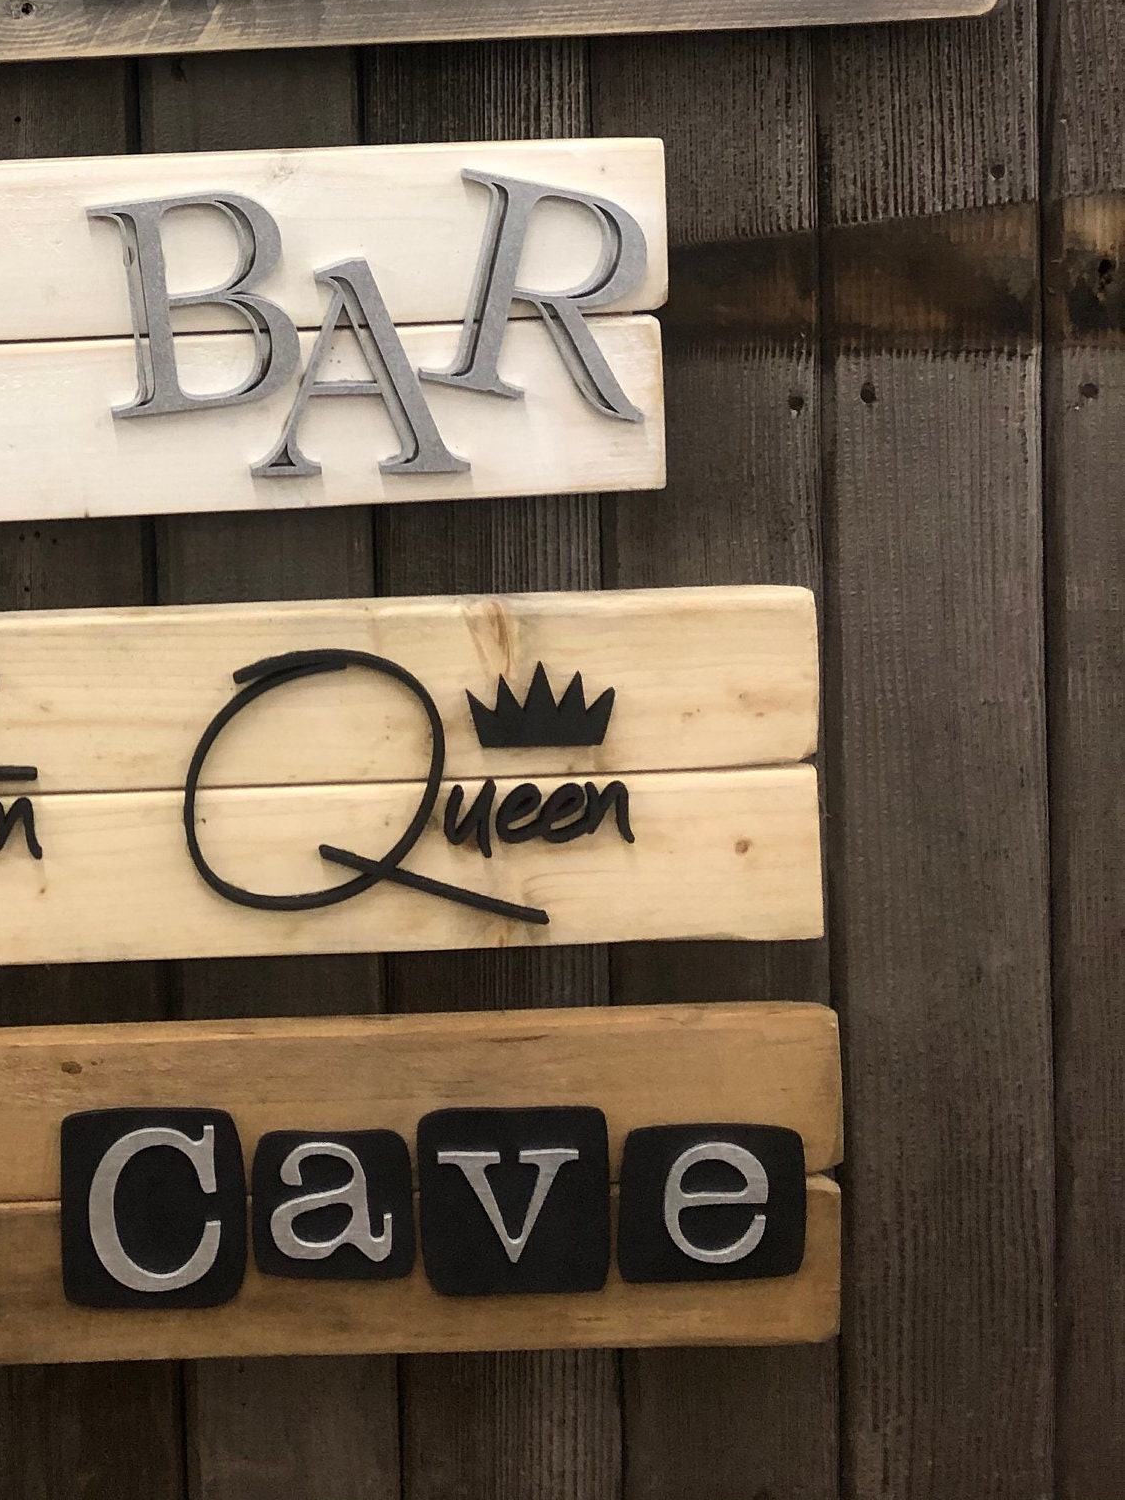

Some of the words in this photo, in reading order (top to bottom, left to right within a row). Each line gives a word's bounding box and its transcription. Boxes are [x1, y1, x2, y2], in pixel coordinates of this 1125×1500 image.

[87, 167, 648, 479] BAR
[184, 648, 635, 926] Queen
[87, 1123, 769, 1293] Cave
